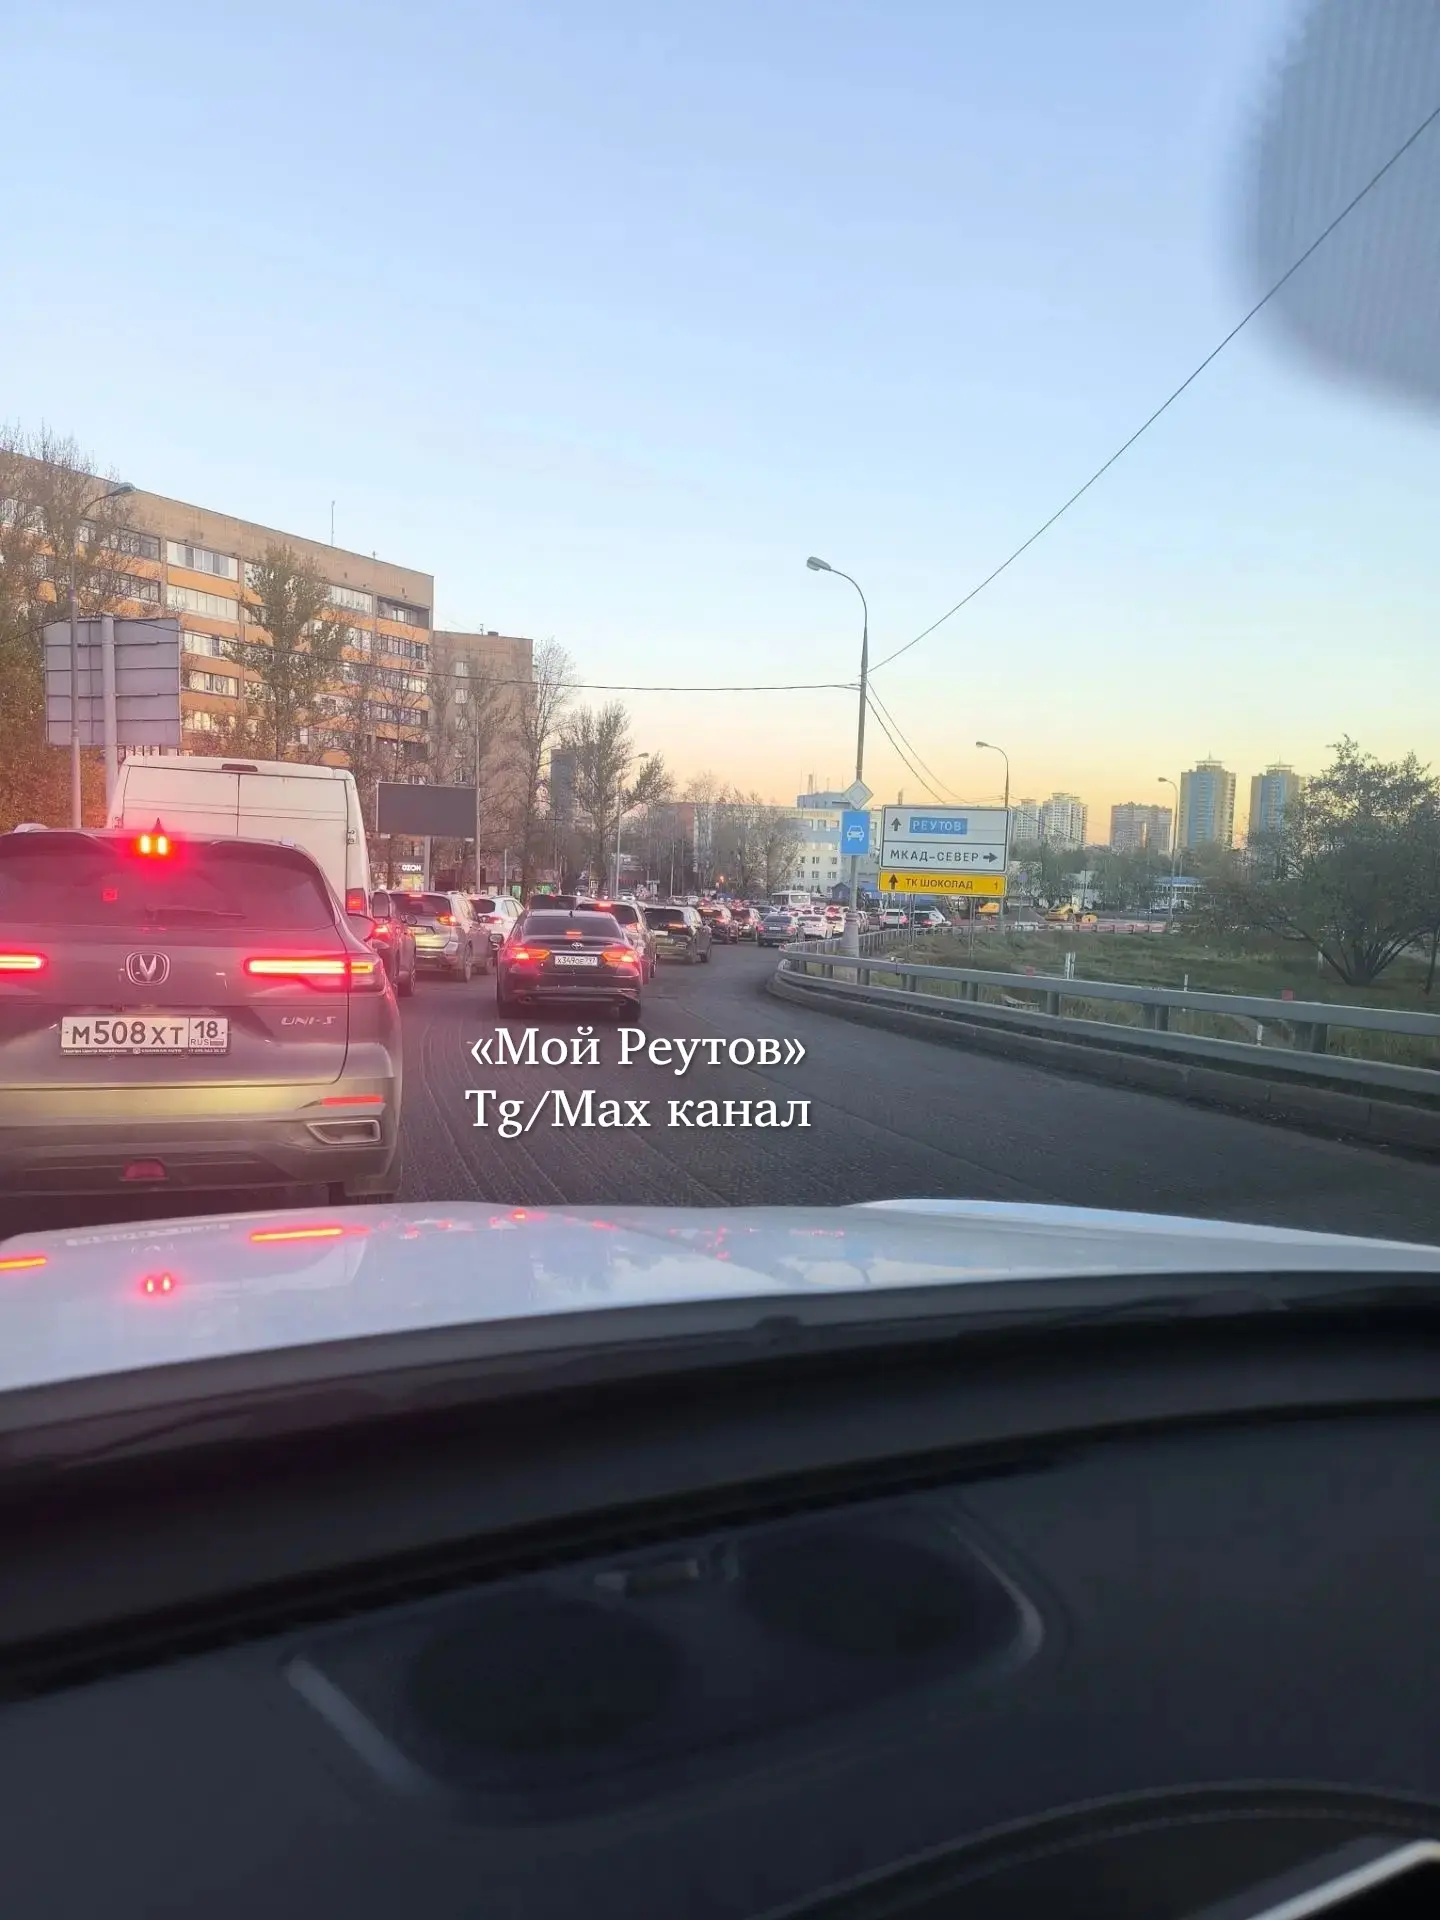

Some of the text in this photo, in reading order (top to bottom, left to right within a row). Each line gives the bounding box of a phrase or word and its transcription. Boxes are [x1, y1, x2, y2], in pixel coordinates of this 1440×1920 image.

[912, 820, 962, 832] РЕУТОВ
[890, 849, 979, 863] МКАД-СЕВЕР
[401, 864, 422, 872] OZON
[906, 878, 917, 887] ТК
[920, 878, 973, 890] ШОКОЛАД
[194, 1021, 218, 1038] 18
[190, 1038, 210, 1046] RUS
